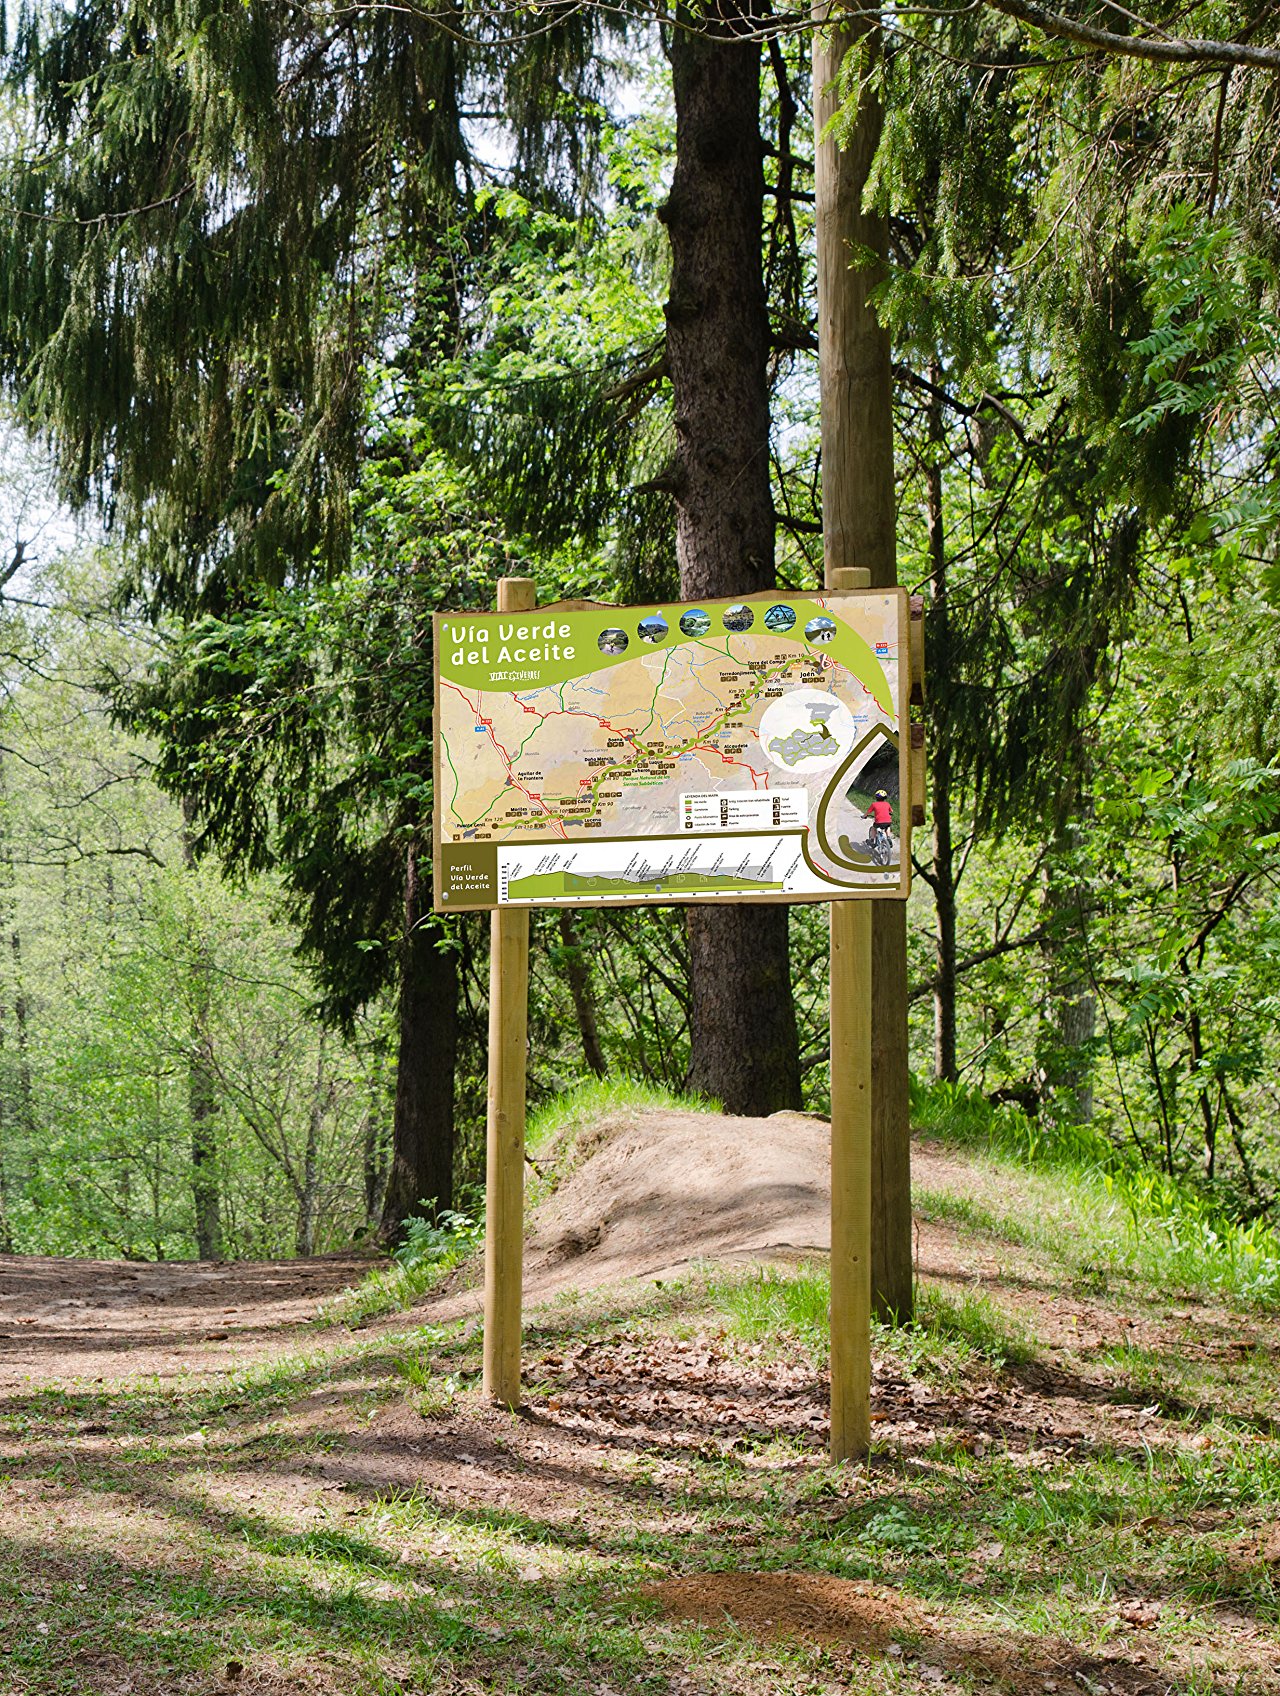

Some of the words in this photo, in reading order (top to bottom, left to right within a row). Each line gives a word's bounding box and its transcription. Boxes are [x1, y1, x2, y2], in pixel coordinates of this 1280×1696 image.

[451, 625, 489, 644] Vía
[499, 621, 571, 642] Verde
[451, 647, 490, 666] del
[497, 643, 576, 664] Aceite
[800, 671, 815, 679] Jaén
[450, 864, 473, 872] Perfil
[450, 874, 464, 882] Vía
[465, 873, 489, 881] Verde
[465, 882, 490, 890] Aceite
